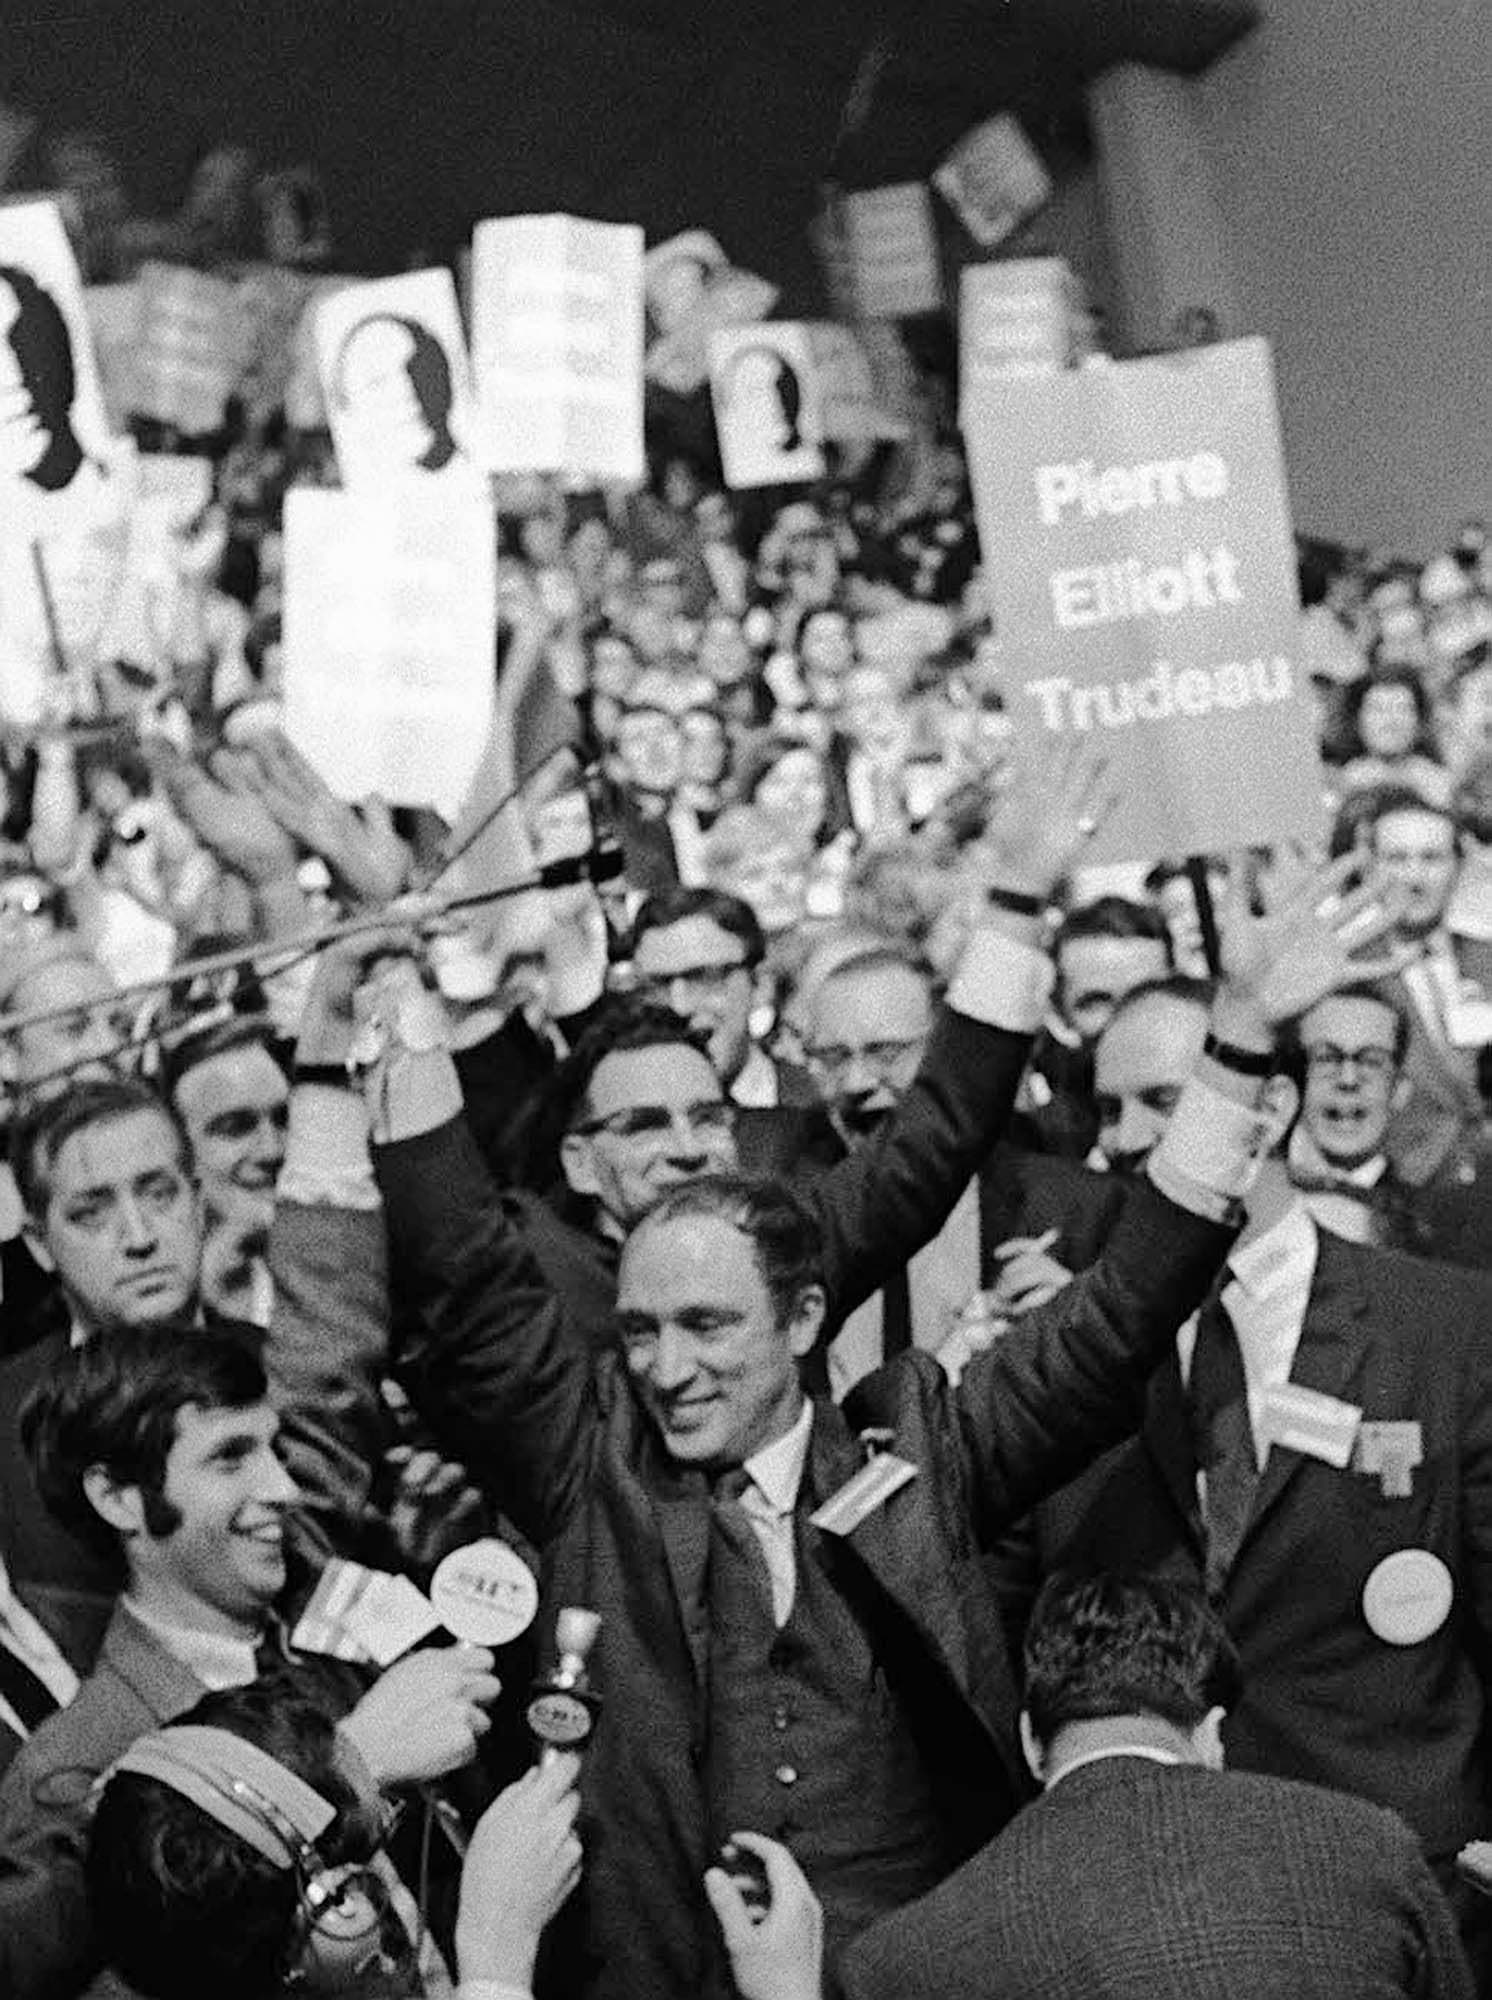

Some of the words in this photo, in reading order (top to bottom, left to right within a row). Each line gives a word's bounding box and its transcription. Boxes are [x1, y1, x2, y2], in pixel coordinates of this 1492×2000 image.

[1036, 451, 1228, 525] Pierre
[1051, 544, 1244, 627] Elliott
[1024, 655, 1292, 730] Trudeau
